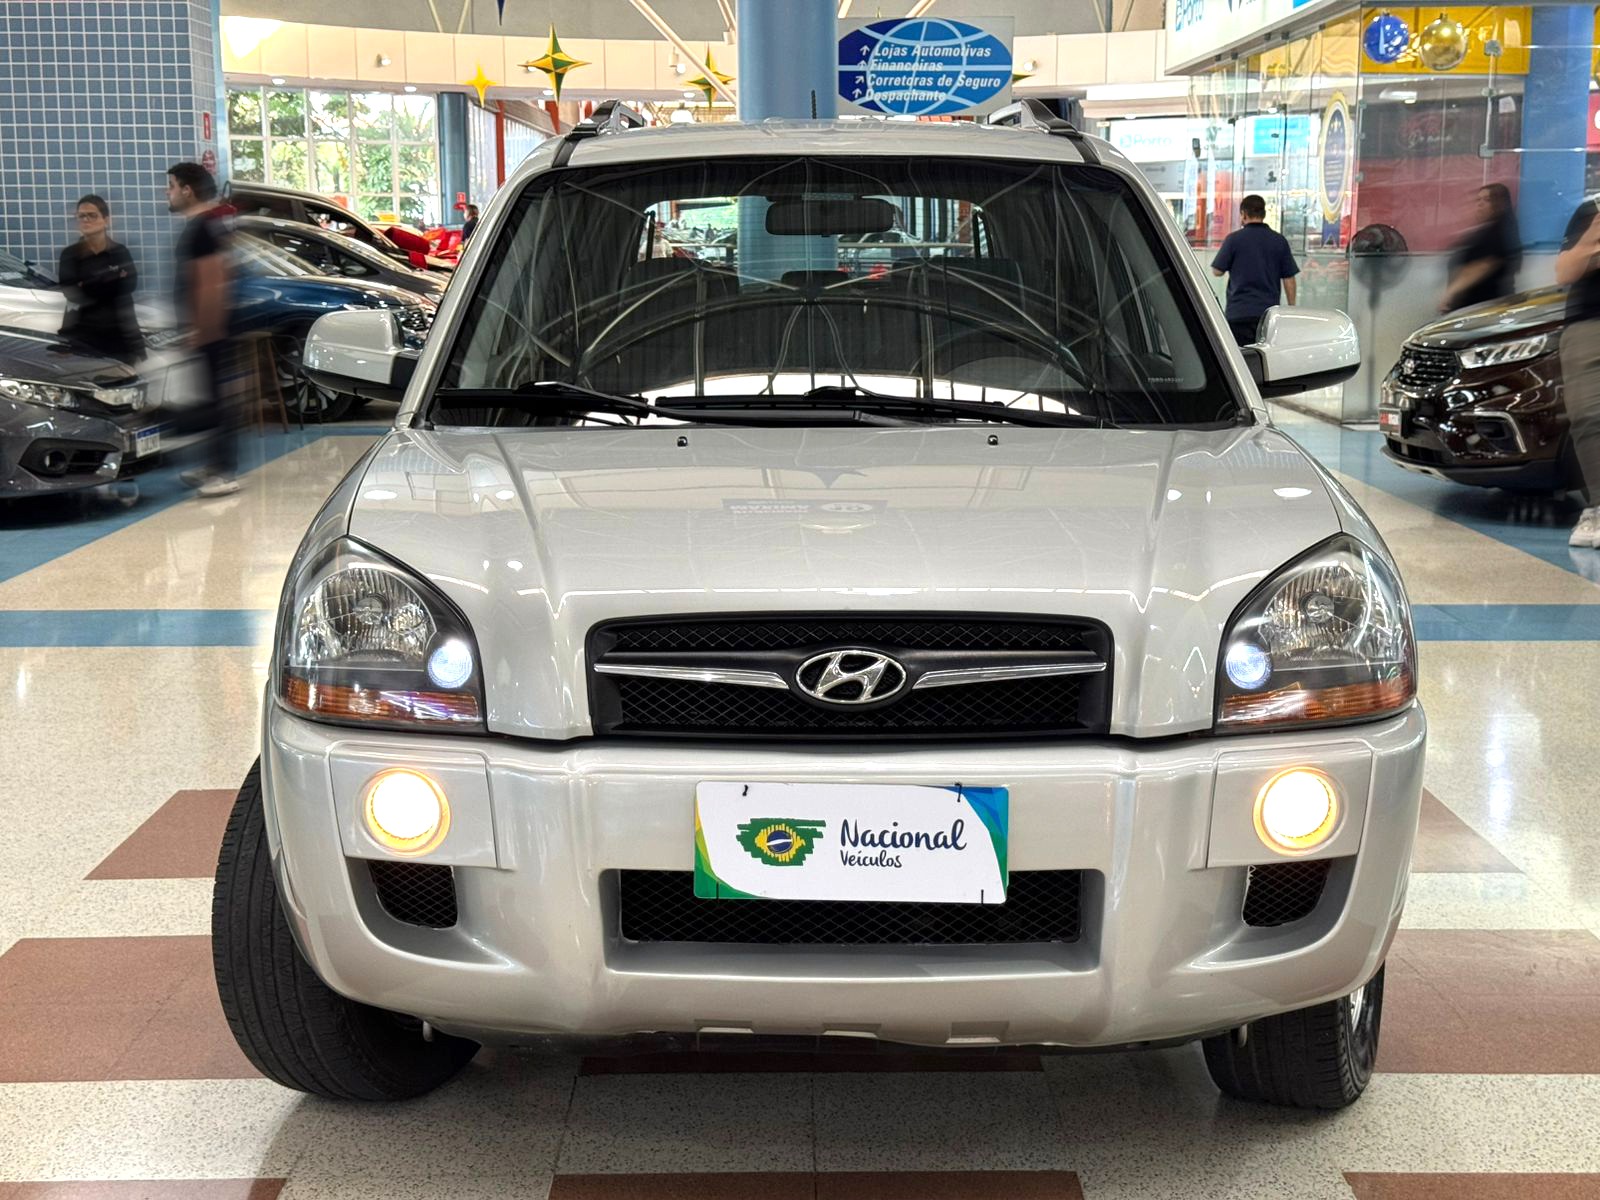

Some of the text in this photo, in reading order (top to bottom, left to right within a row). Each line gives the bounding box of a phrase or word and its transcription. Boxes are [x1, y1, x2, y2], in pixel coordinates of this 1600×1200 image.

[874, 44, 992, 58] Lojas Automotivas
[870, 60, 944, 72] Financeiras
[868, 74, 1001, 89] Corretoras de Seguro
[865, 89, 947, 102] Despachante
[840, 818, 968, 851] Nacional
[840, 849, 902, 868] Veículos
